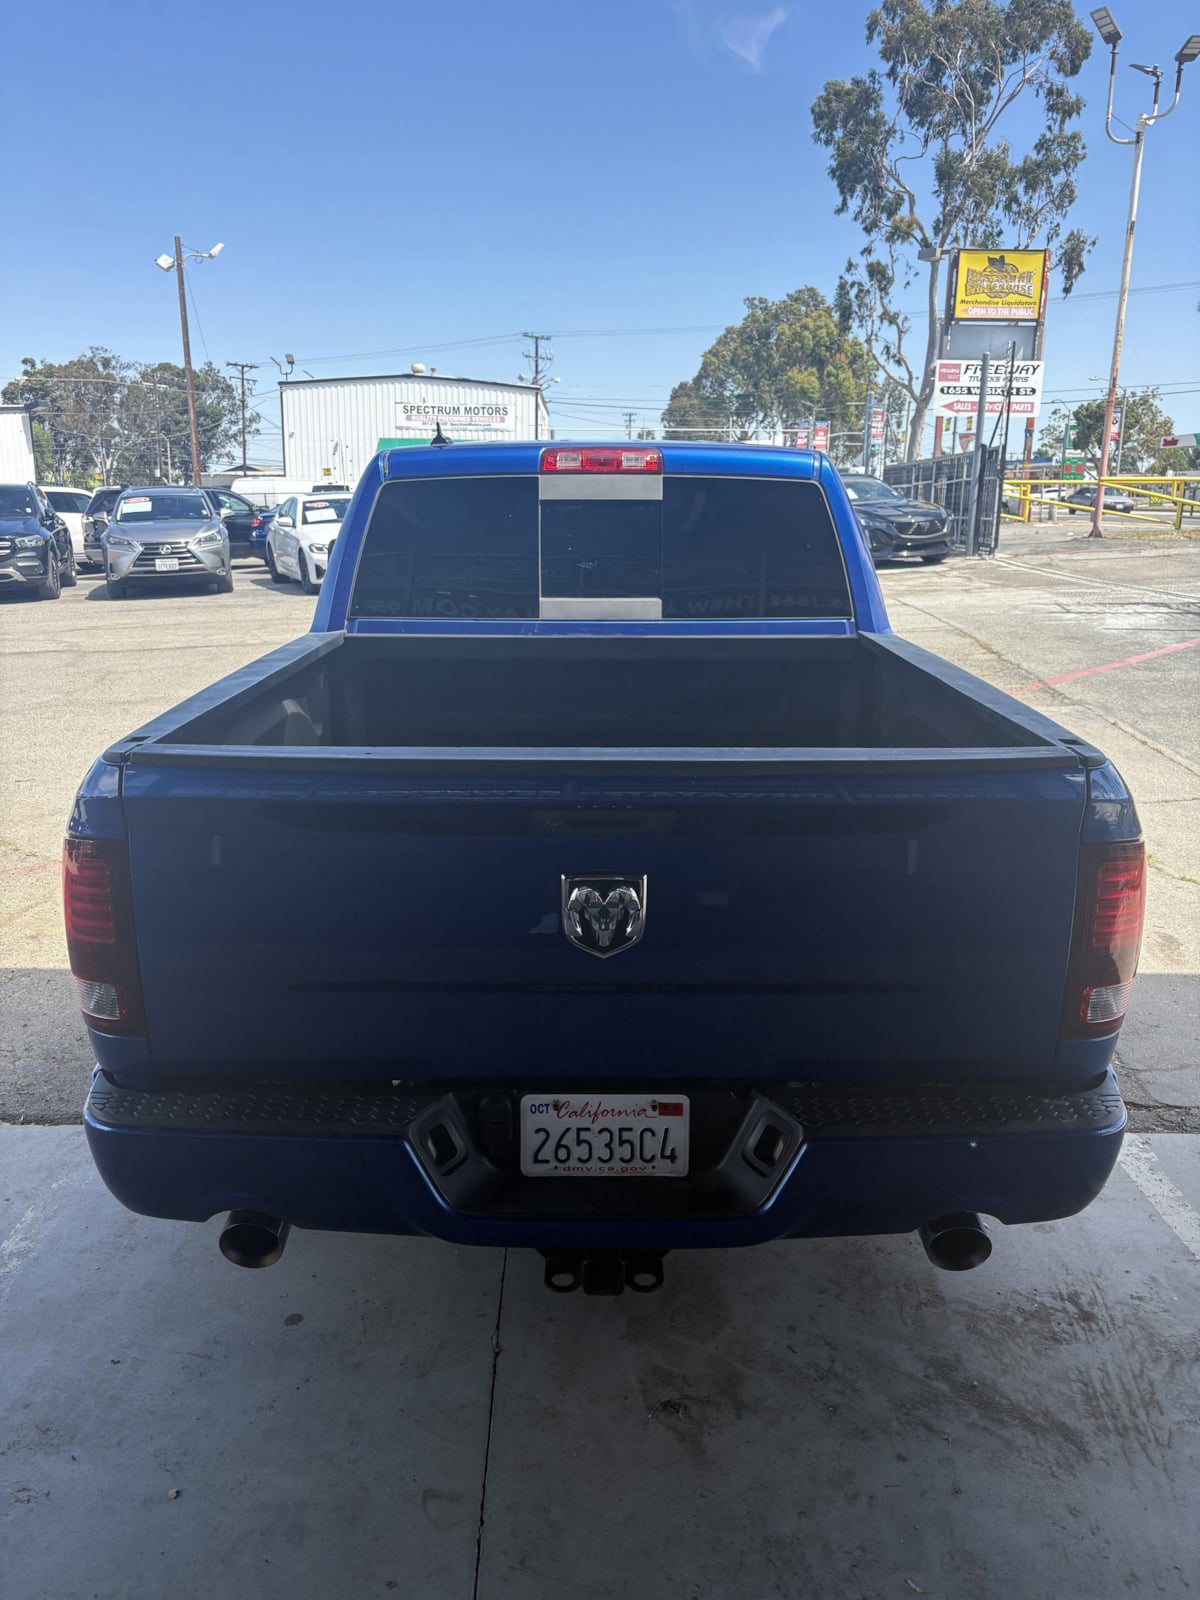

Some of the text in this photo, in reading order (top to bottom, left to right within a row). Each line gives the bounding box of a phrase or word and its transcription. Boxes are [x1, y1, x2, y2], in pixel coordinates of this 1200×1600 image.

[1001, 299, 1037, 307] Liquidators
[967, 307, 1034, 316] OPEN TO THE PUBLIC
[969, 375, 1001, 383] TRUKS
[985, 387, 1016, 395] SIXH
[402, 405, 509, 416] SPECTRUM MOTORS
[953, 403, 972, 411] SALES
[1012, 403, 1032, 411] PARTS
[530, 1103, 550, 1115] OCT
[556, 1101, 659, 1124] California
[533, 1127, 677, 1164] 26535C4
[563, 1165, 647, 1173] dmv.ca.gov
